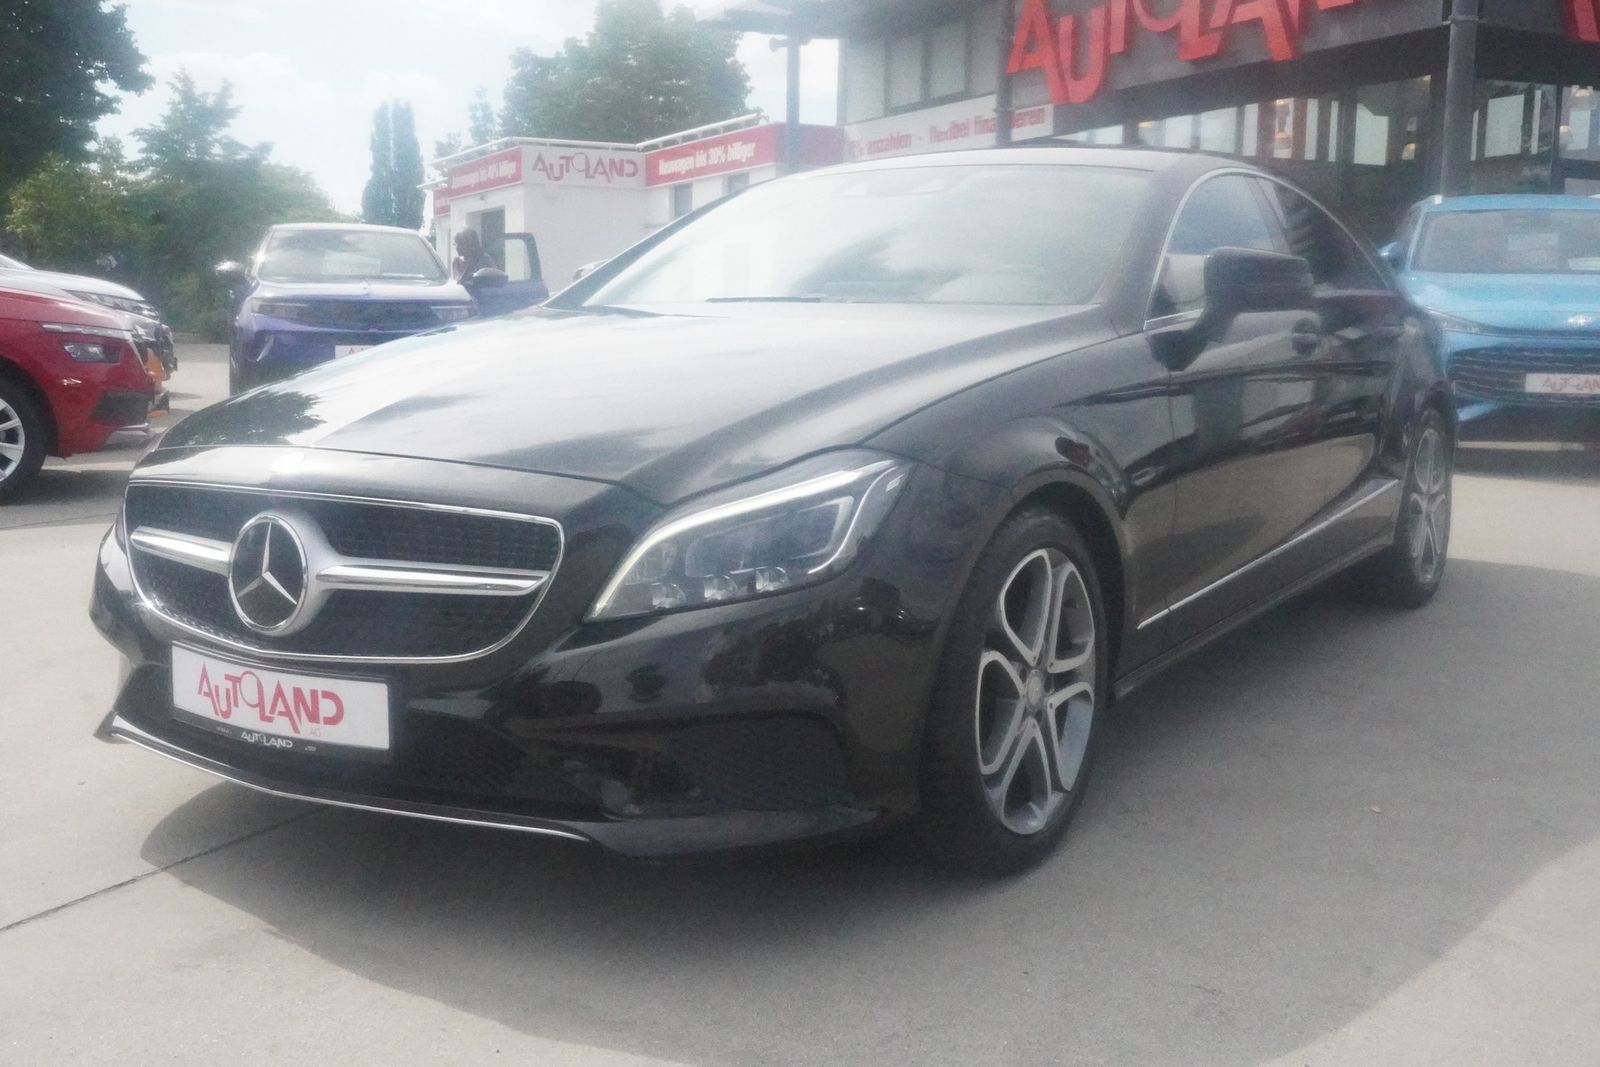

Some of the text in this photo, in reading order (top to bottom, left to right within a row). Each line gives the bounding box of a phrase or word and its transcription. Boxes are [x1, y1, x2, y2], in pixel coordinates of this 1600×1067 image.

[1005, 0, 1364, 105] AUTLA
[532, 152, 639, 184] AUTOLAND
[197, 661, 345, 735] AUTOLAND
[240, 731, 294, 749] AUTOLAND
